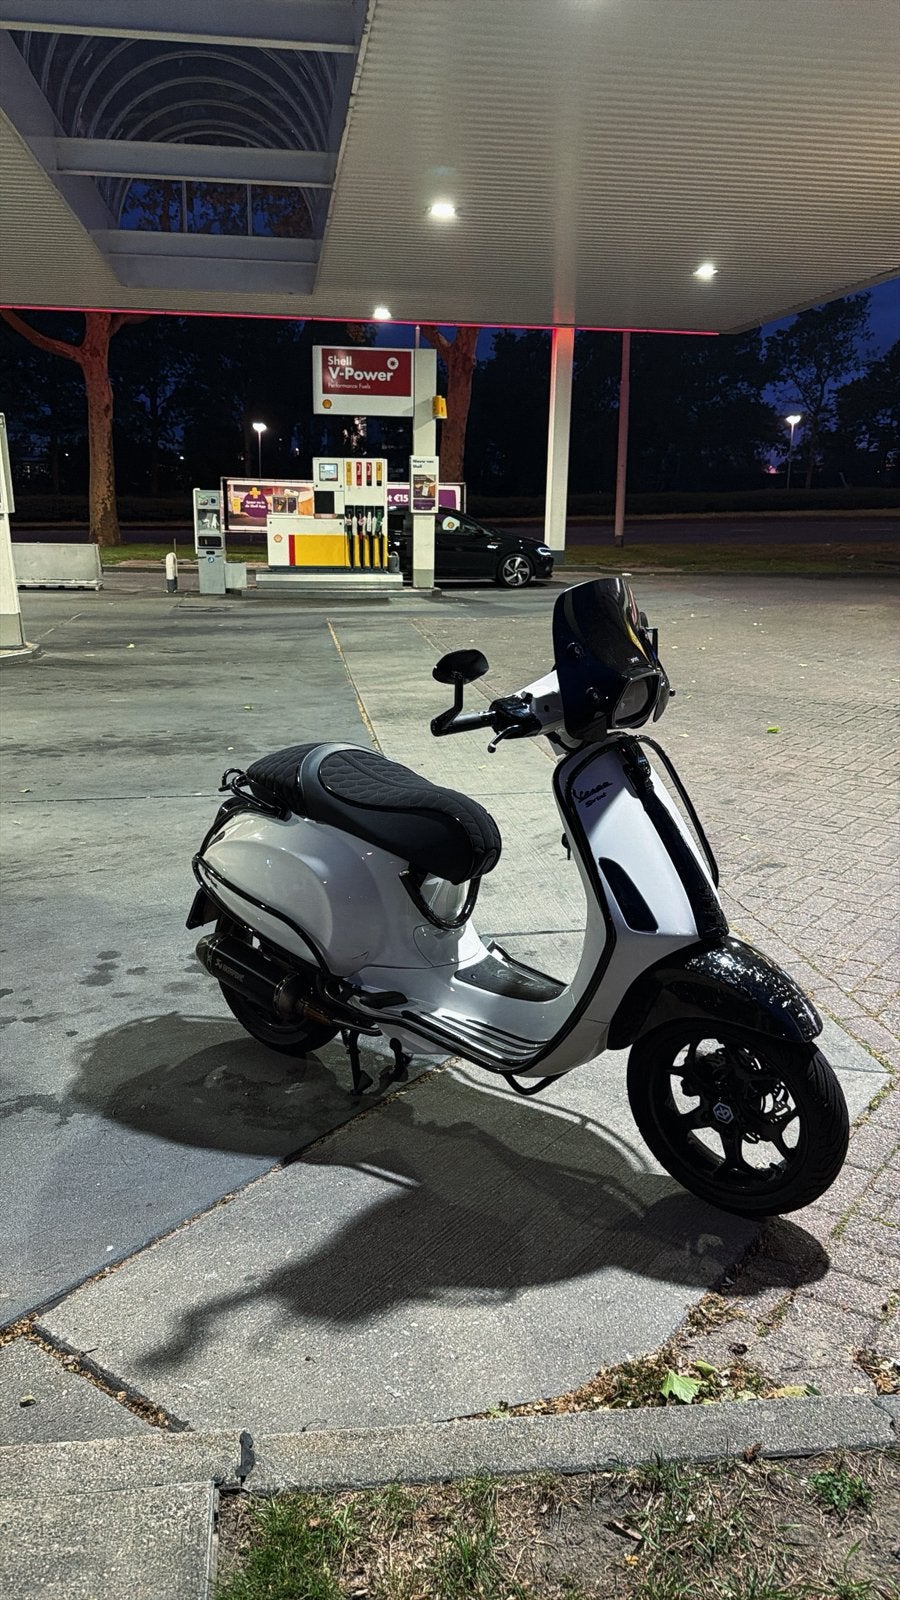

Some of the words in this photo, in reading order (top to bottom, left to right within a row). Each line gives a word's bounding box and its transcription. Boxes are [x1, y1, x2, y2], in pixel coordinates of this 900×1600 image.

[328, 355, 352, 366] Shell
[328, 367, 394, 381] V-Power
[393, 494, 409, 503] €15
